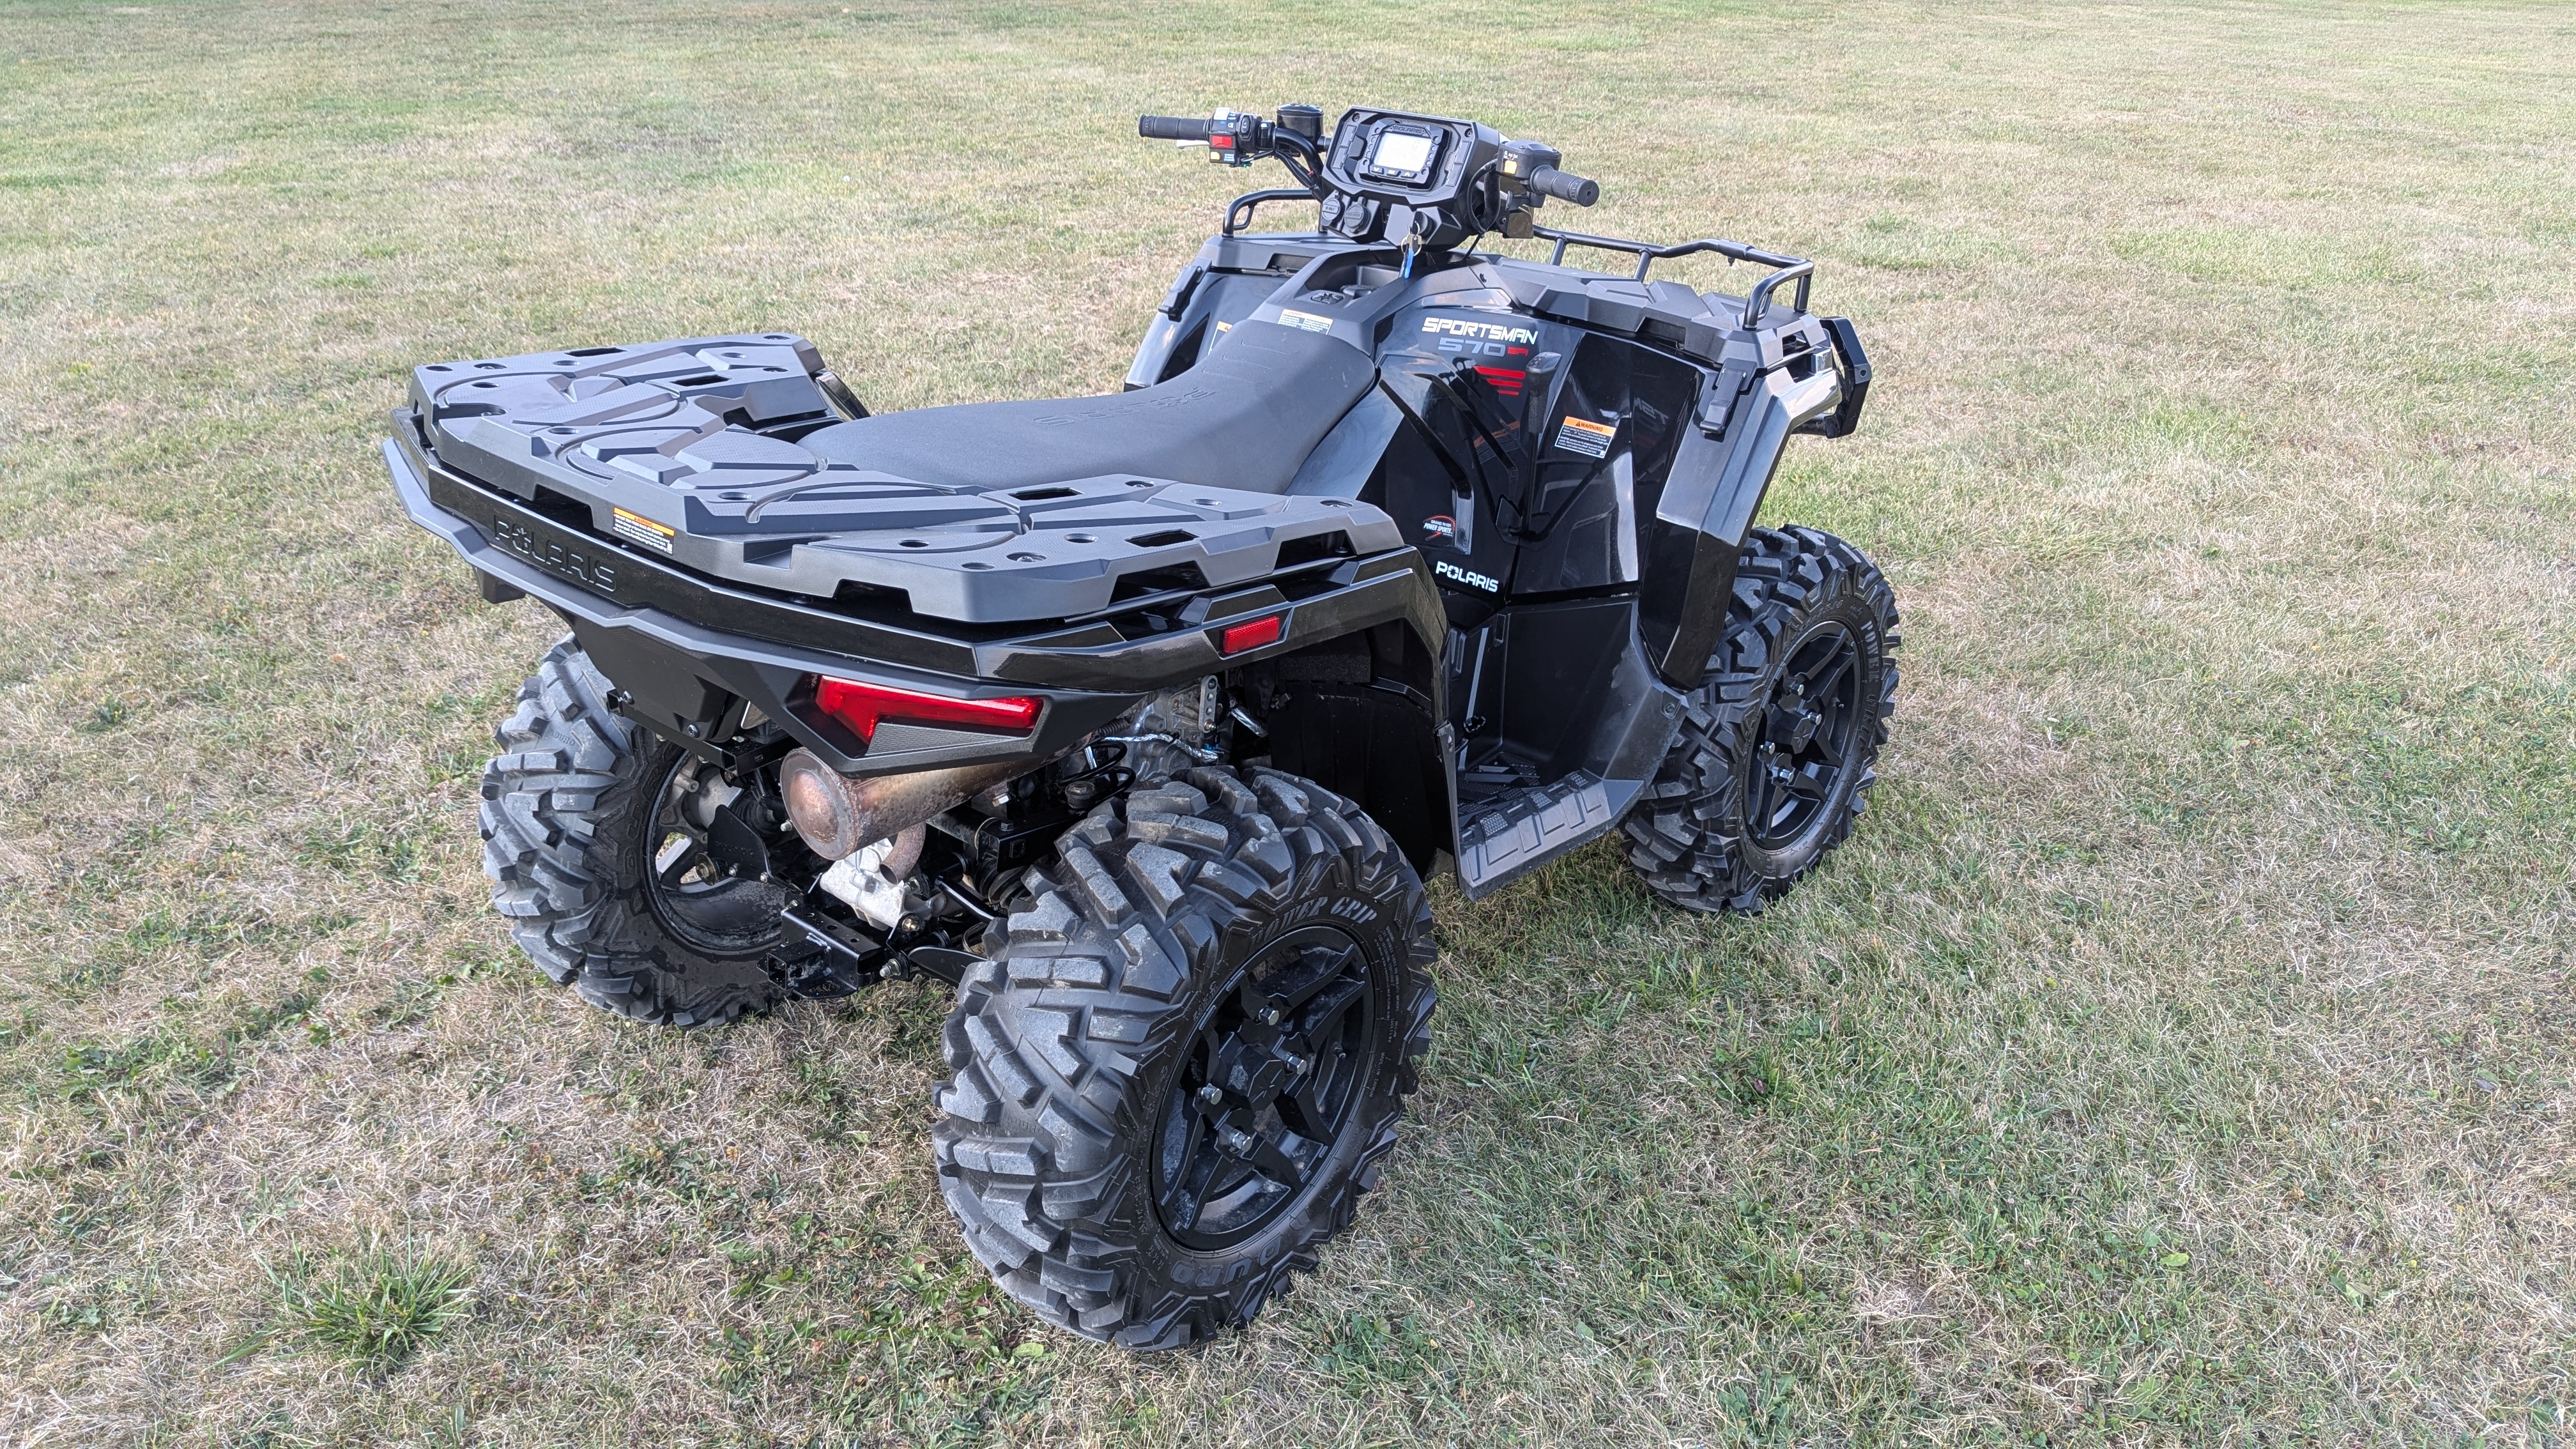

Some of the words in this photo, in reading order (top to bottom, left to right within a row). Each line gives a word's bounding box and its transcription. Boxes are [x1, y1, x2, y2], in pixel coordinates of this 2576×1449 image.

[1422, 317, 1538, 345] SPORTSMAN
[1438, 337, 1506, 357] 570
[1580, 422, 1604, 432] WARNING
[1423, 522, 1438, 530] POWER
[1437, 525, 1452, 533] SPORTS
[493, 514, 617, 592] POLARIS
[1436, 560, 1499, 593] POLARIS
[1860, 620, 1880, 683] POWER
[1330, 896, 1377, 924] GRIP
[1170, 1231, 1282, 1287] DURO
